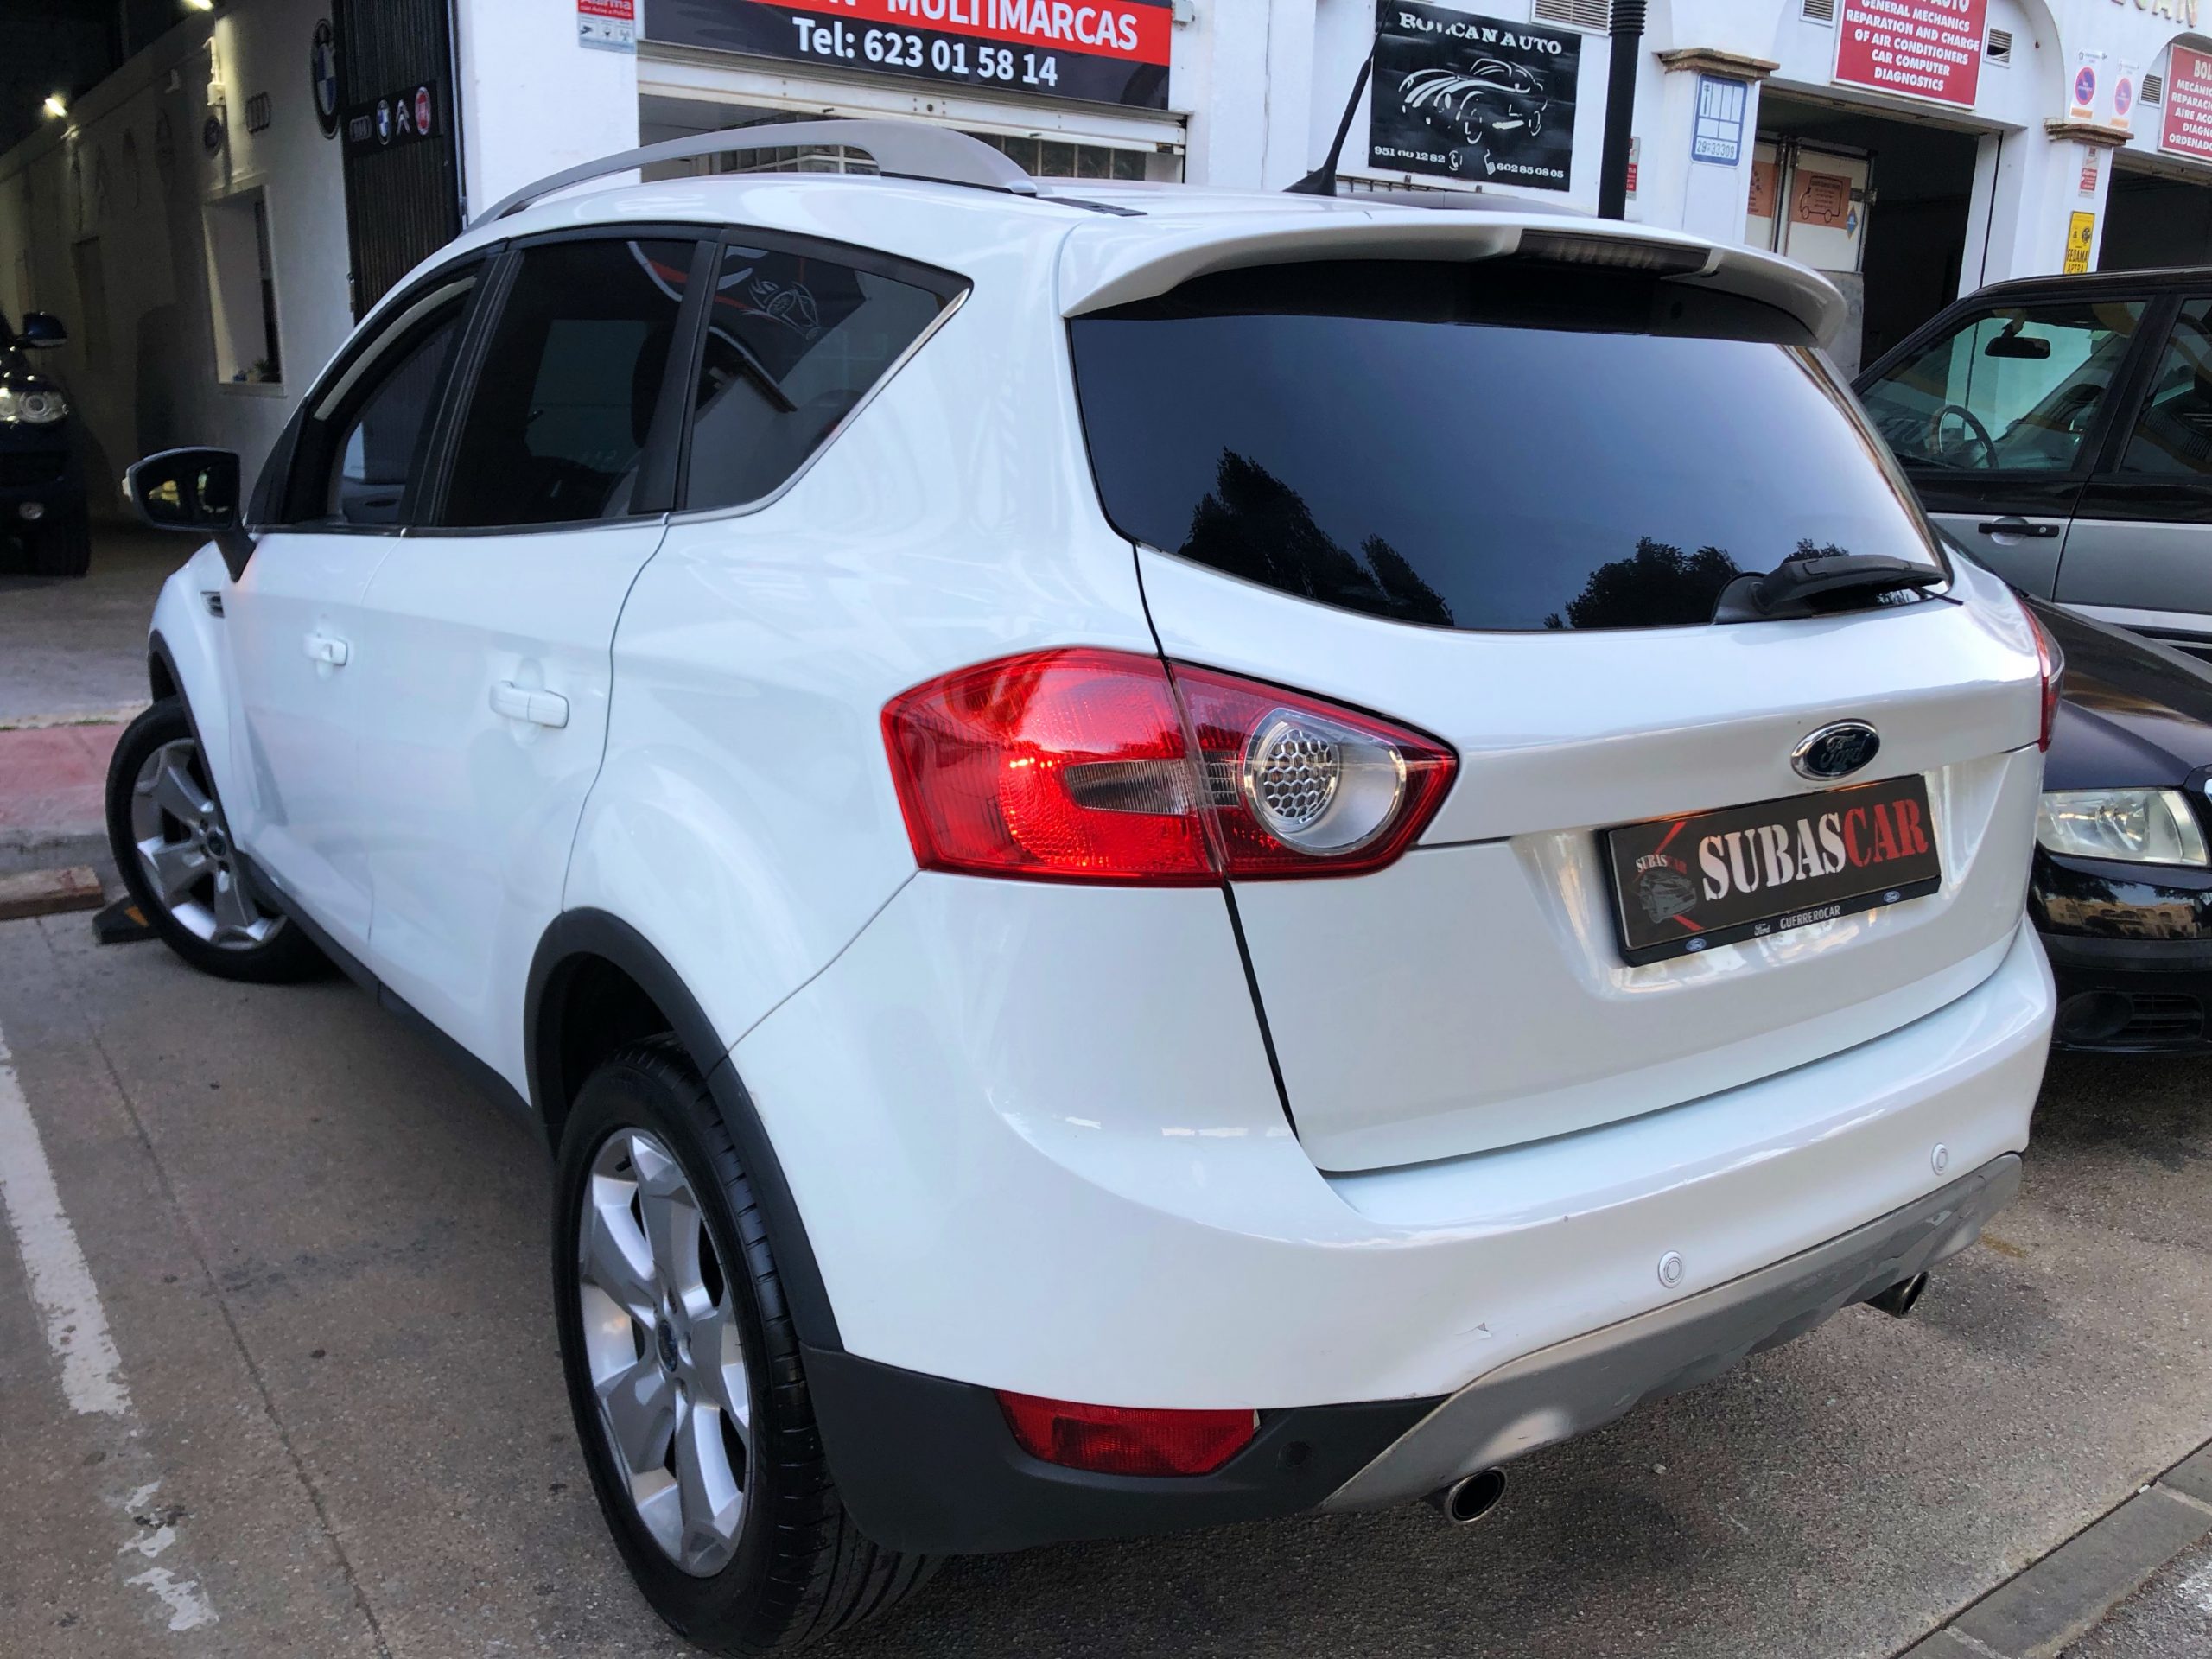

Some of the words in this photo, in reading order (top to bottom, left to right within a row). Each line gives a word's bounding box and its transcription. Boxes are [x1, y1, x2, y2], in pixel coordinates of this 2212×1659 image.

[1862, 0, 1910, 17] GENERAL
[1912, 8, 1970, 32] MECHANICS
[1930, 0, 1970, 13] TO
[1500, 31, 1562, 54] AUTO
[1847, 9, 1913, 35] REPARATION
[1916, 26, 1938, 41] AND
[1942, 32, 1980, 52] CHARGE
[792, 16, 855, 58] Tel:
[864, 29, 924, 68] 623
[931, 40, 969, 74] 01
[977, 47, 1014, 80] 58
[1022, 53, 1058, 86] 14
[1854, 29, 1870, 41] OF
[1872, 34, 1891, 47] AIR
[1894, 37, 1968, 65] CONDITIONERS
[1872, 49, 1892, 64] CAR
[1896, 54, 1950, 76] COMPUTER
[1874, 67, 1944, 92] DIAGNOSTICS
[2175, 107, 2195, 121] AIRE
[1374, 145, 1395, 157] 951
[1415, 151, 1428, 161] 12
[1429, 153, 1446, 163] 82
[1496, 162, 1518, 173] 602
[1519, 165, 1534, 175] 85
[1535, 167, 1549, 176] 08
[1550, 169, 1564, 178] 05
[1819, 734, 1867, 768] Ford
[1699, 798, 1929, 901] SUBASCAR
[1754, 922, 1770, 936] Ford
[1780, 905, 1840, 930] GUERREROCAR
